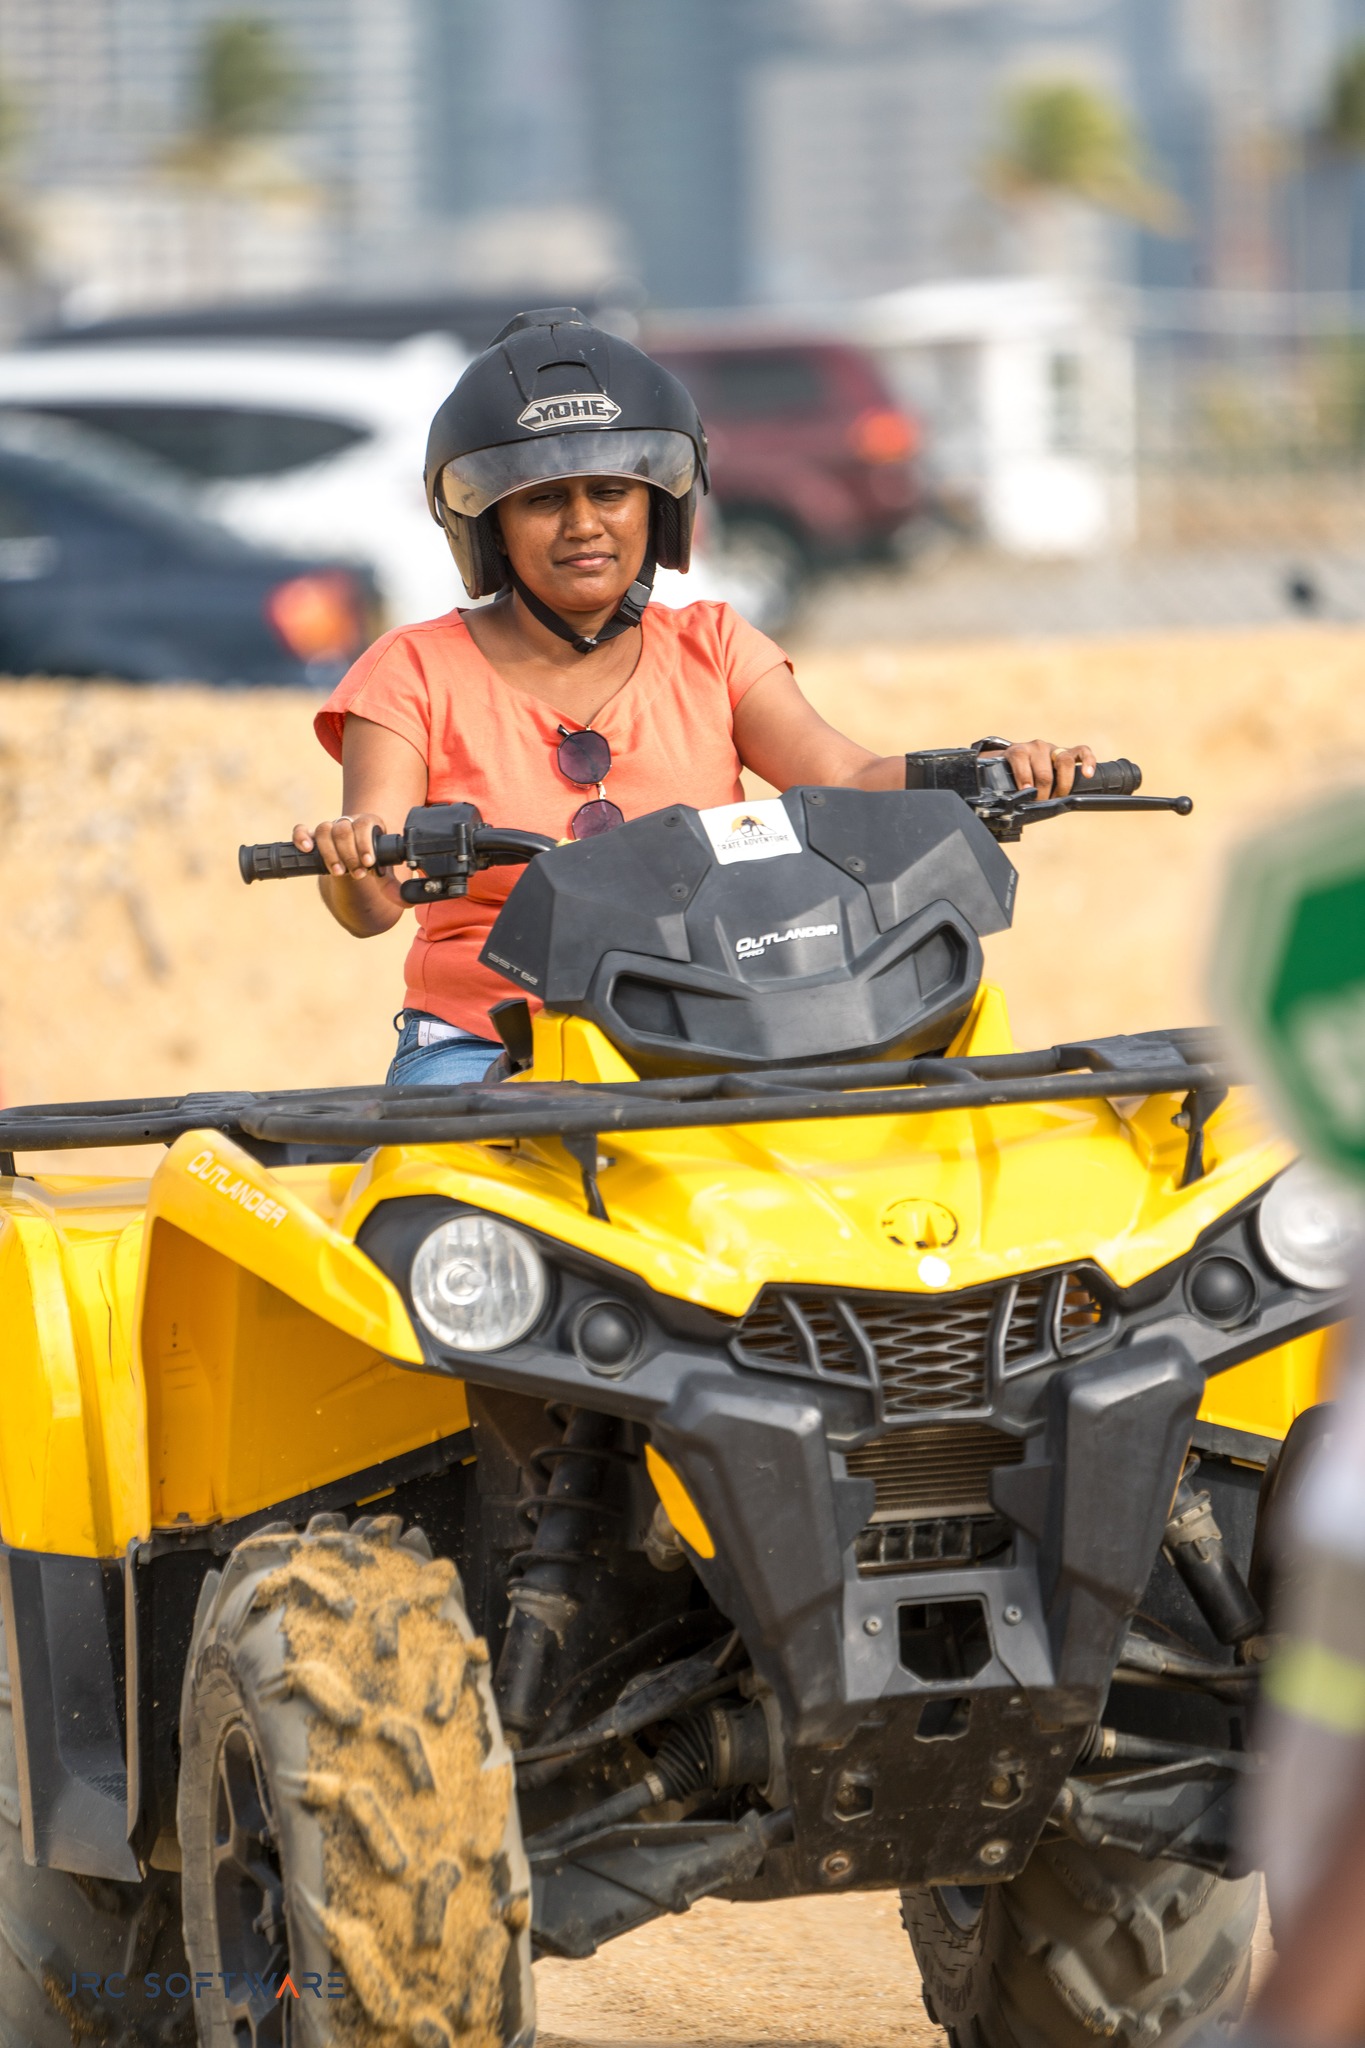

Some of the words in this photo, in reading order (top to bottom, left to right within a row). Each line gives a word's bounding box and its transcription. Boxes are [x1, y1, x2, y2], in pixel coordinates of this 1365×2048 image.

[531, 399, 611, 422] YOHE
[743, 834, 789, 846] ADVENTURE
[736, 924, 838, 952] OUTLANDER
[738, 948, 765, 960] PRO
[186, 1150, 289, 1229] OUTLANDER
